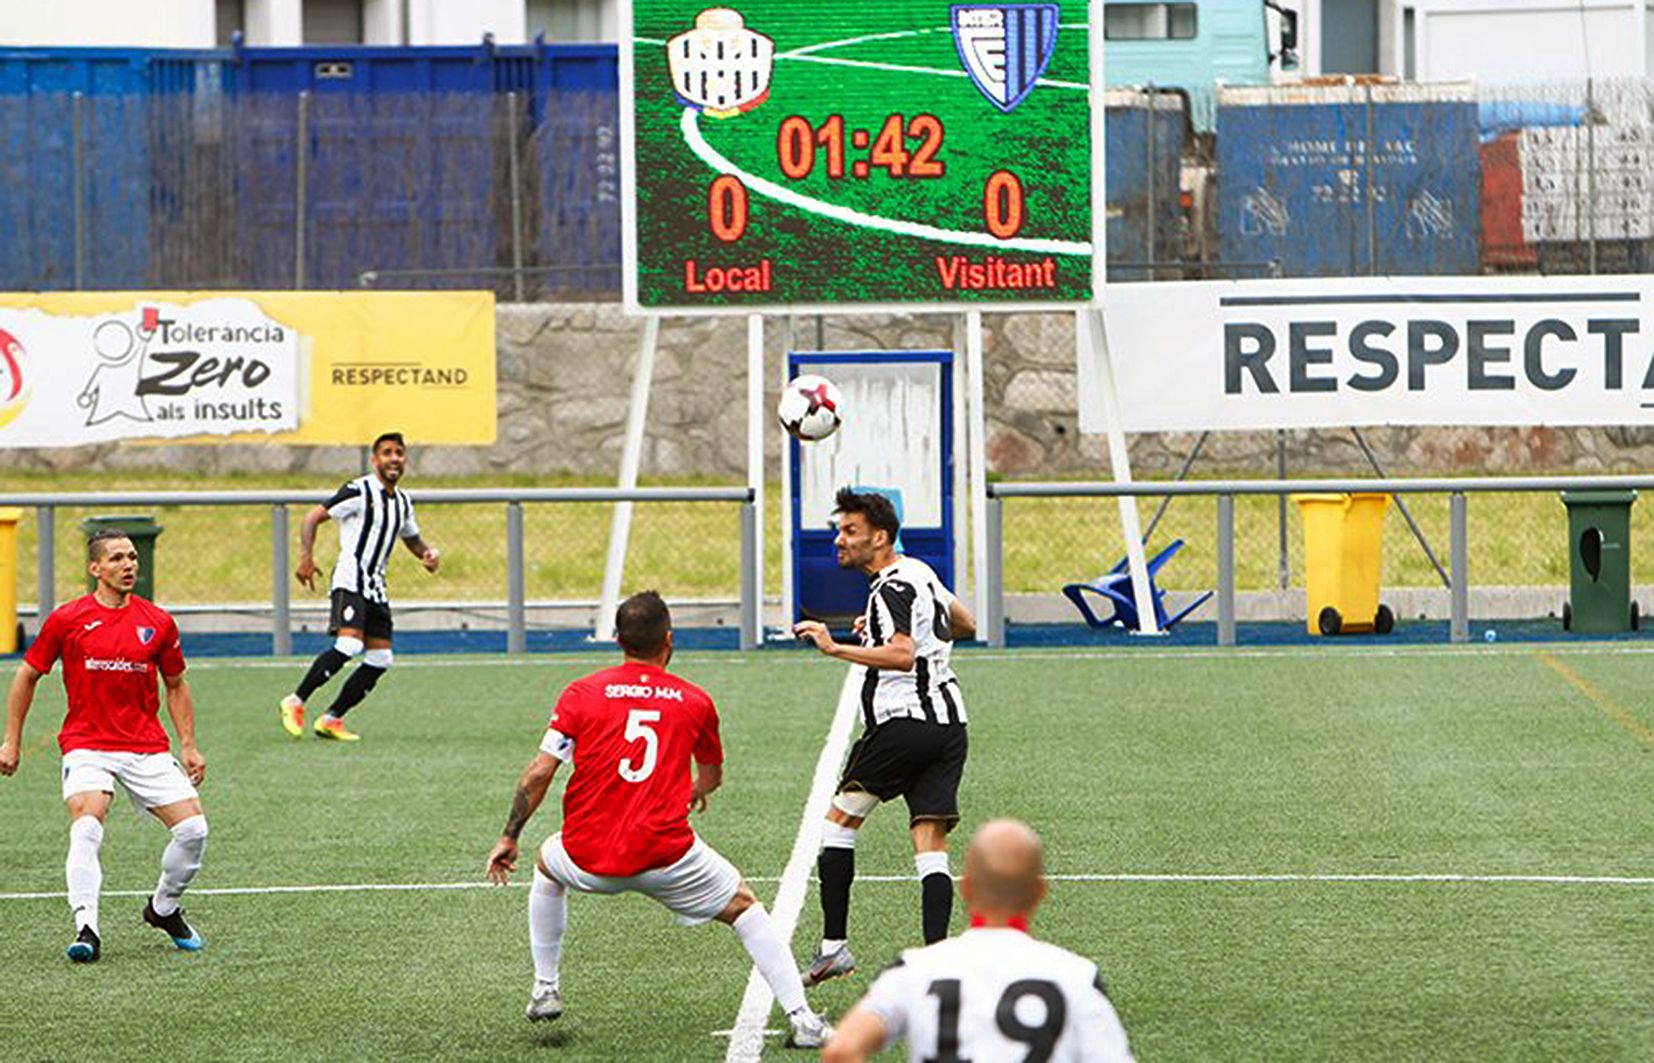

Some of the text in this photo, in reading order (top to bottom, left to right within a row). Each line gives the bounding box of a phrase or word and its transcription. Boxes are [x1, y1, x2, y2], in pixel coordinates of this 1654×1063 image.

[777, 114, 944, 179] 01:42
[709, 174, 748, 242] 0
[983, 170, 1023, 239] 0
[685, 260, 771, 293] Local
[936, 256, 1056, 289] Visitant
[135, 351, 271, 397] Zero
[331, 368, 468, 385] RESPECTAND
[1224, 319, 1654, 394] RESPECT
[156, 398, 282, 420] als insults
[604, 684, 653, 699] SERGIO
[618, 709, 661, 783] 5
[925, 978, 1067, 1063] 19
